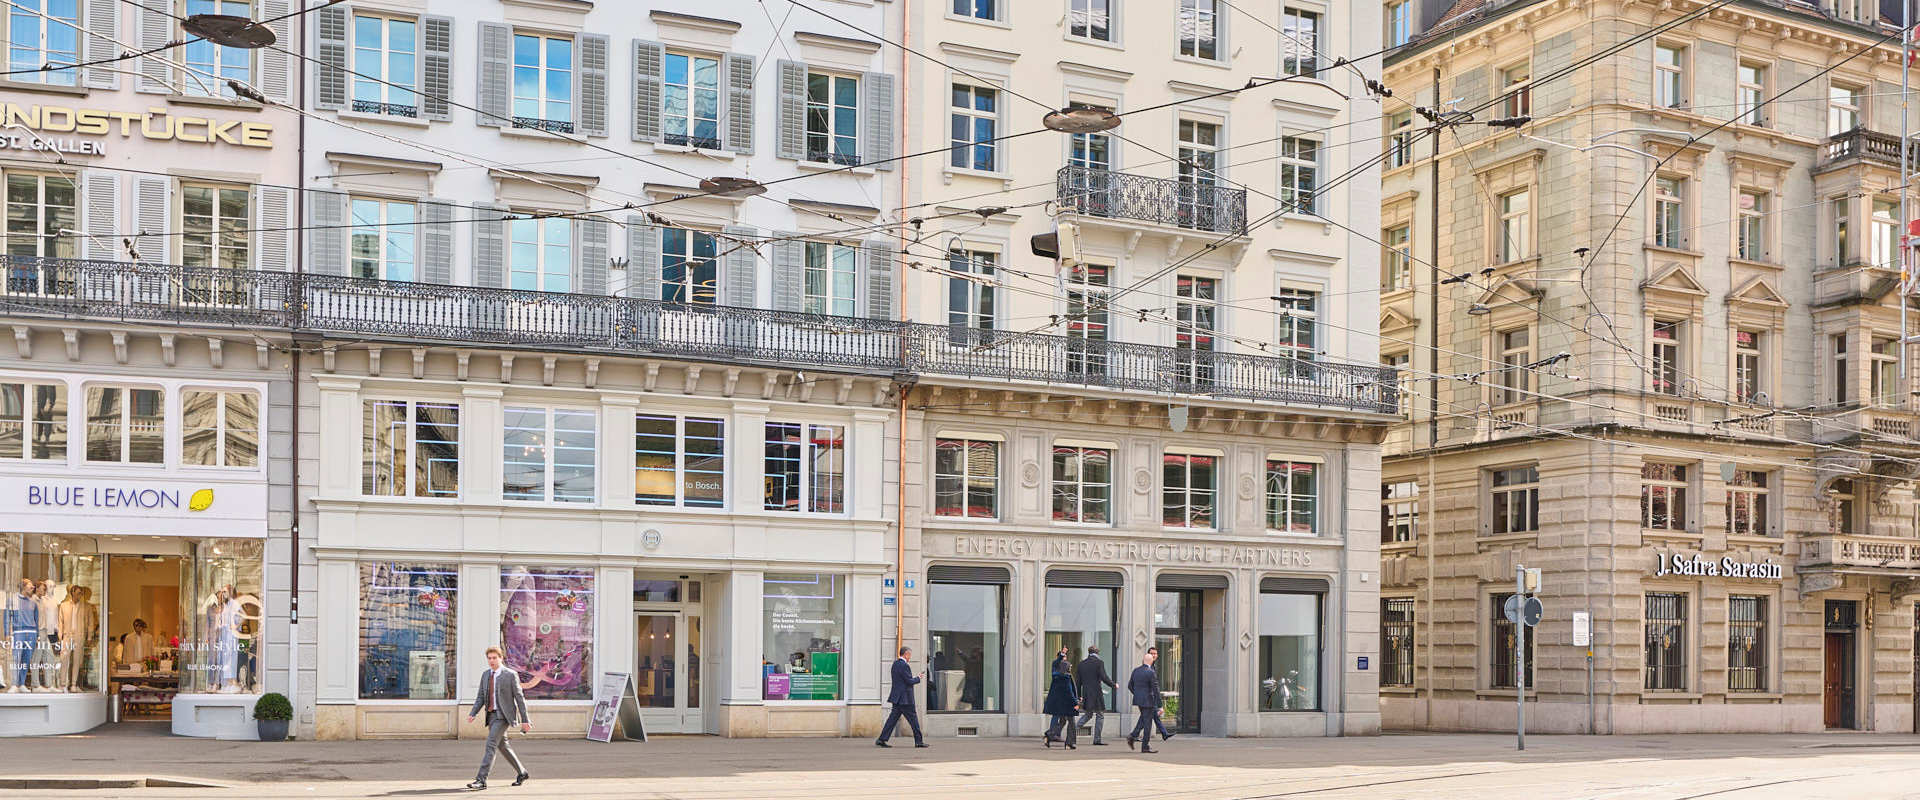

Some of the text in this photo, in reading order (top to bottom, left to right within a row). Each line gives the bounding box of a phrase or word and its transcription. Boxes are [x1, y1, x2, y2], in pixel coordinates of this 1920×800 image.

[0, 102, 273, 149] NDSTÜCKE
[29, 136, 105, 155] GALLEN
[685, 481, 693, 489] to
[695, 481, 722, 490] Bosch.
[29, 486, 179, 508] BLUE LEMON
[955, 536, 1312, 567] ENERGY INFRASTRUCTURE PARTNERS
[1656, 553, 1783, 579] J. Safra Sarasin
[37, 636, 50, 650] in
[54, 637, 78, 655] style
[198, 638, 209, 652] in
[213, 638, 245, 656] style
[10, 662, 54, 670] BLUE LEMON
